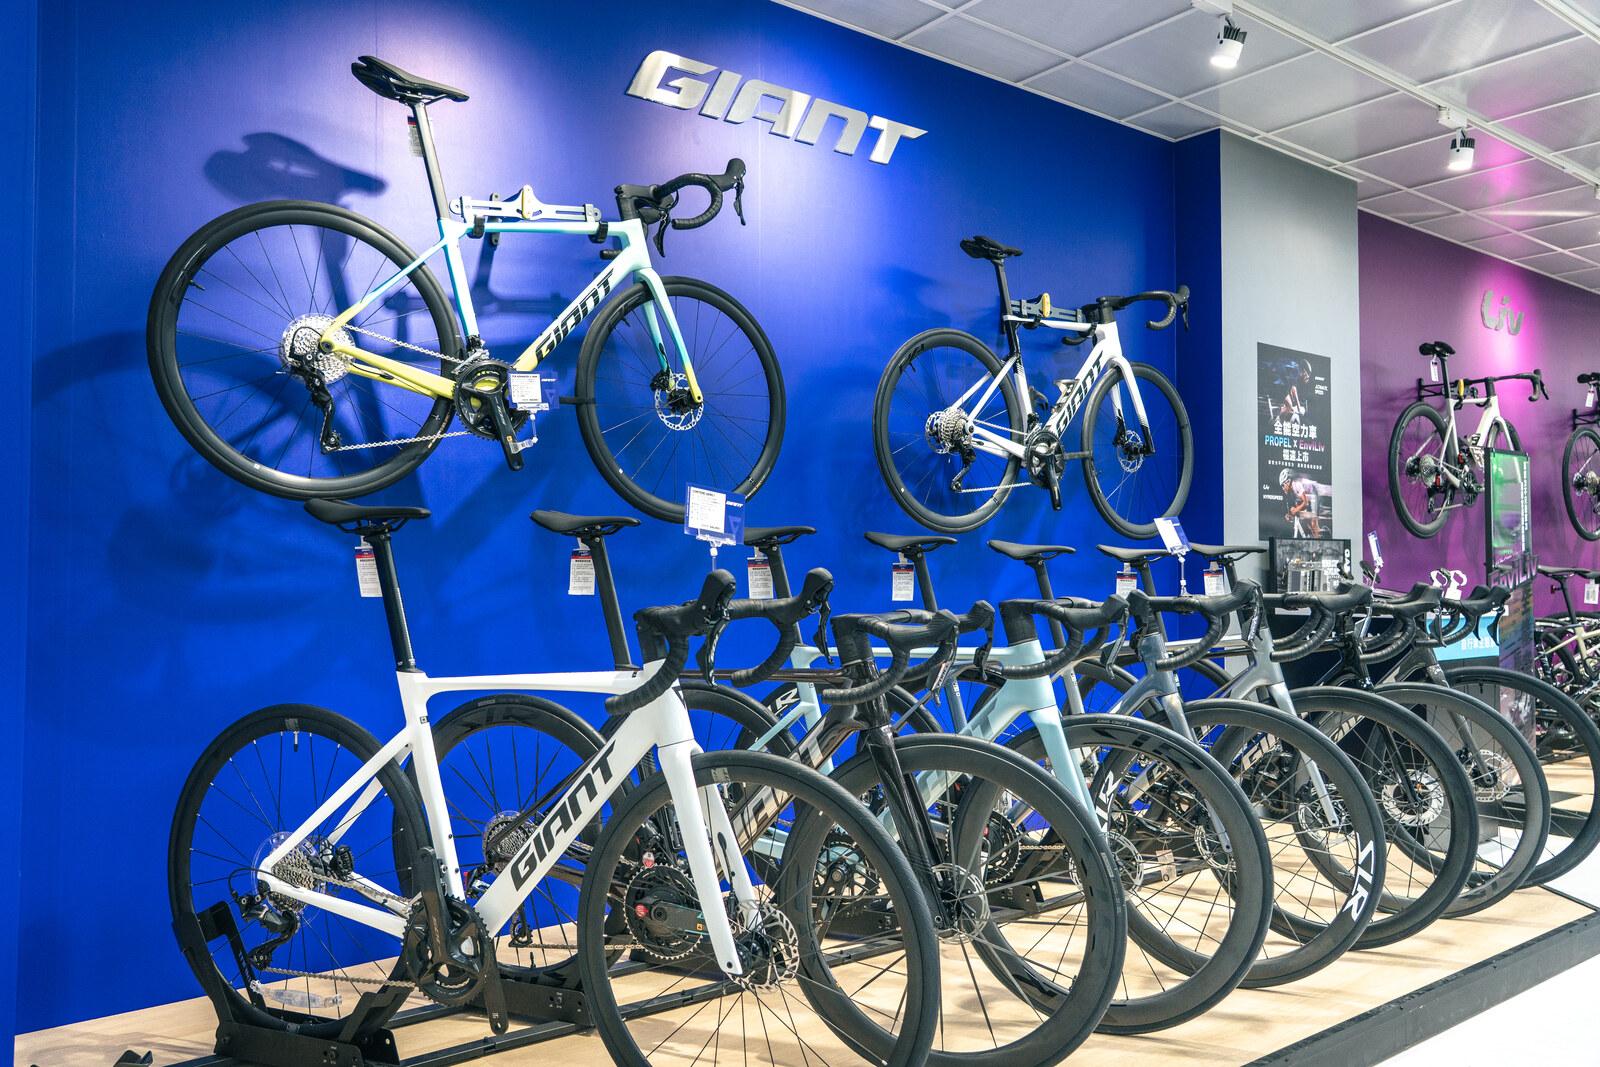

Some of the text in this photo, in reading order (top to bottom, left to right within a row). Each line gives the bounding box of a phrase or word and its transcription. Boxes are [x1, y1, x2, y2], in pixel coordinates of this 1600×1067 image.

[625, 50, 928, 165] GIANT
[535, 268, 614, 364] GIANT
[1481, 290, 1524, 336] Liv
[1057, 350, 1104, 437] GIANT
[1264, 434, 1292, 448] PROPEL
[510, 738, 616, 892] GIANT
